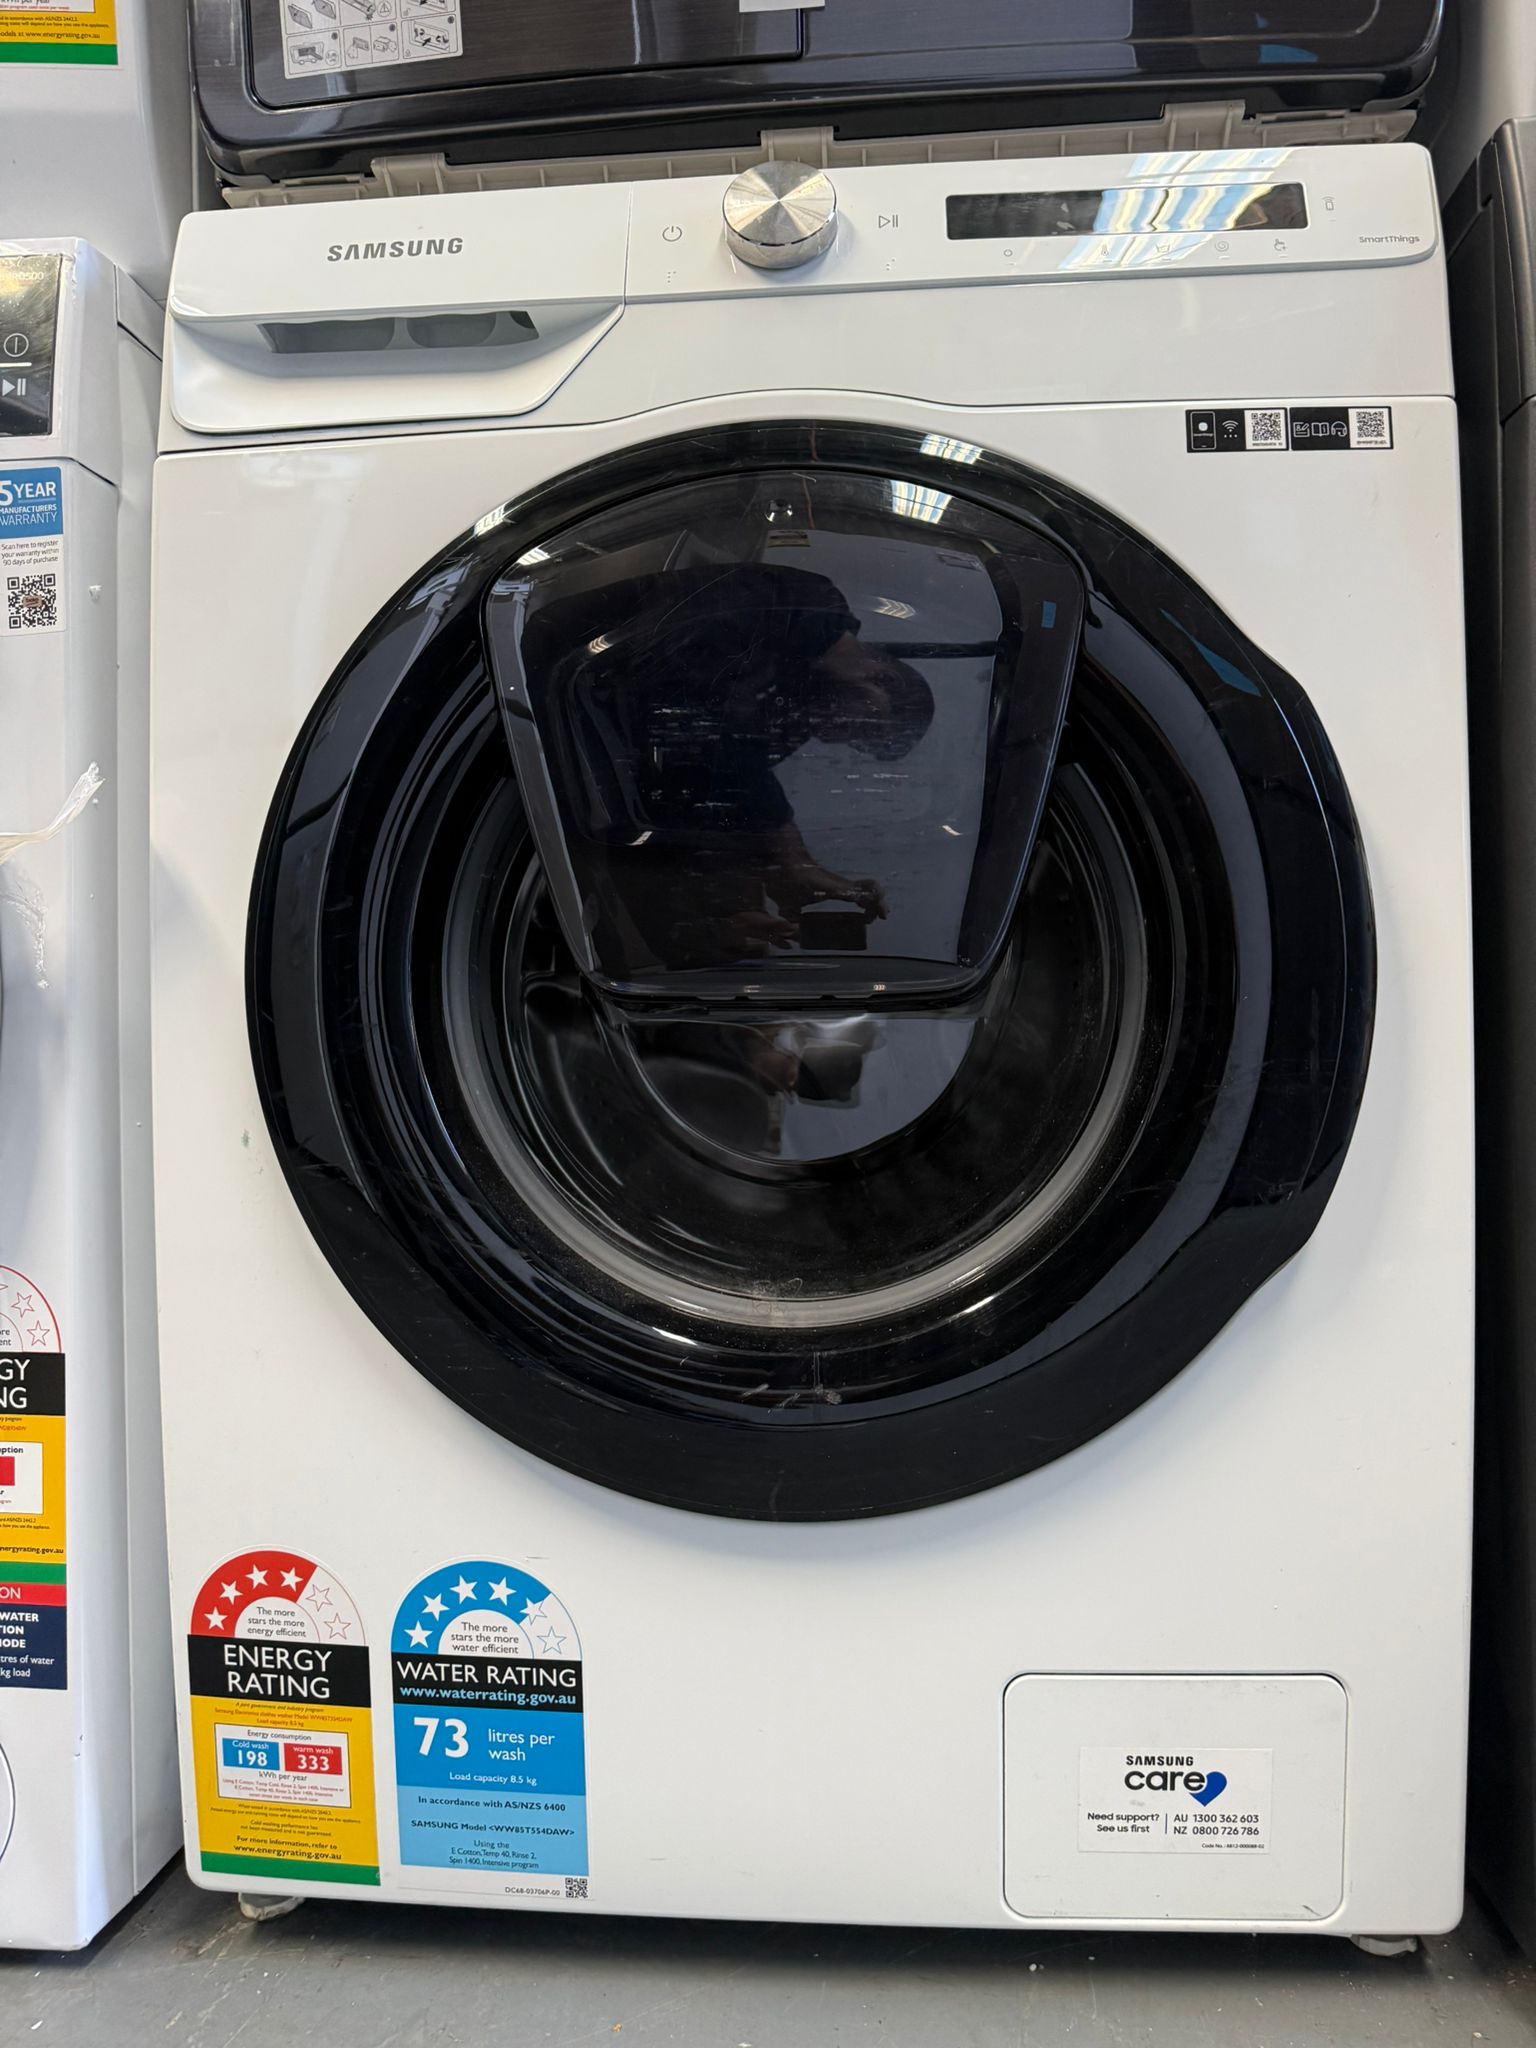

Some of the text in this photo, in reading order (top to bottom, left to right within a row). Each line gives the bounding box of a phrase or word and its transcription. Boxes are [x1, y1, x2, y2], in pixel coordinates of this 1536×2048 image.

[1359, 235, 1420, 244] SmartThings
[327, 237, 464, 262] SAMSUNG
[13, 481, 56, 498] YEAR
[0, 512, 57, 526] WARRANTY
[37, 540, 58, 548] register
[33, 556, 58, 565] purchase
[0, 1446, 24, 1455] ption
[0, 1611, 39, 1623] WATER
[257, 1606, 272, 1616] The
[248, 1617, 305, 1628] stars the more
[462, 1621, 508, 1633] The more
[247, 1627, 307, 1638] energy efficient
[451, 1633, 519, 1644] stars the more
[452, 1643, 519, 1654] water efficient
[20, 1655, 29, 1664] of
[30, 1657, 55, 1665] water
[224, 1644, 332, 1672] ENERGY
[0, 1667, 31, 1679] kg load
[397, 1661, 576, 1688] WATER RATING
[227, 1671, 330, 1699] RATING
[399, 1687, 576, 1706] www.waterrating.gov.au
[247, 1729, 312, 1742] Energy consumption
[413, 1716, 555, 1759] 73 litres per
[232, 1739, 270, 1750] Cold wash
[293, 1745, 334, 1755] warm wash
[237, 1750, 268, 1767] 198
[488, 1747, 526, 1761] wash
[297, 1754, 330, 1771] 333
[1126, 1755, 1194, 1766] SAMSUNG
[258, 1771, 307, 1783] kWh per year
[449, 1772, 537, 1787] Load capacity 8.5 kg
[1124, 1770, 1206, 1792] care
[418, 1796, 566, 1812] In accordance with AS/NZS 6400
[1087, 1812, 1160, 1823] Need support?
[1174, 1814, 1259, 1824] AU 1300 362 603
[411, 1819, 459, 1830] SAMSUNG
[461, 1822, 487, 1832] Model
[1096, 1824, 1150, 1833] See us first
[1173, 1826, 1260, 1836] NZ 0800 726 786
[236, 1835, 248, 1843] For
[250, 1837, 268, 1845] more
[269, 1838, 311, 1848] information,
[312, 1841, 328, 1849] refer
[474, 1839, 510, 1850] Using the
[233, 1845, 342, 1860] www.energyrating.gov.au
[451, 1847, 456, 1855] E
[448, 1856, 463, 1865] Spin
[511, 1861, 539, 1870] program
